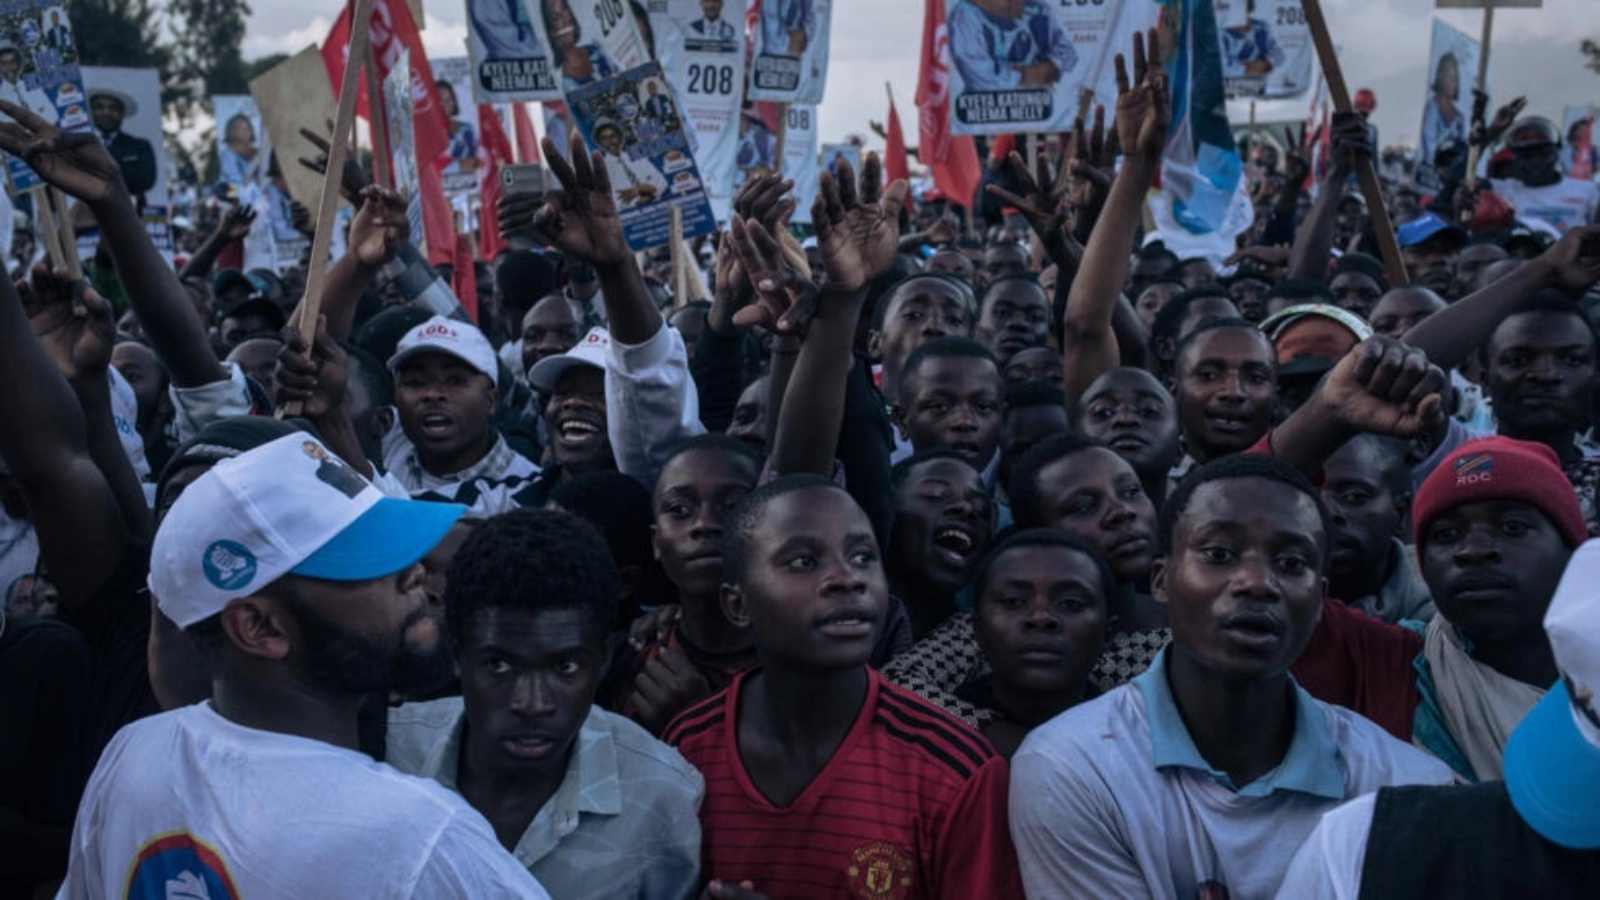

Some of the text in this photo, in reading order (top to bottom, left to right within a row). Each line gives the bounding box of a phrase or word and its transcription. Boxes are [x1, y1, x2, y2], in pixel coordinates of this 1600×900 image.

[491, 74, 535, 91] NEEMA
[687, 64, 733, 95] 208
[787, 109, 810, 131] 08
[966, 104, 1044, 122] NEEMA NELLY
[1456, 471, 1492, 486] RDC
